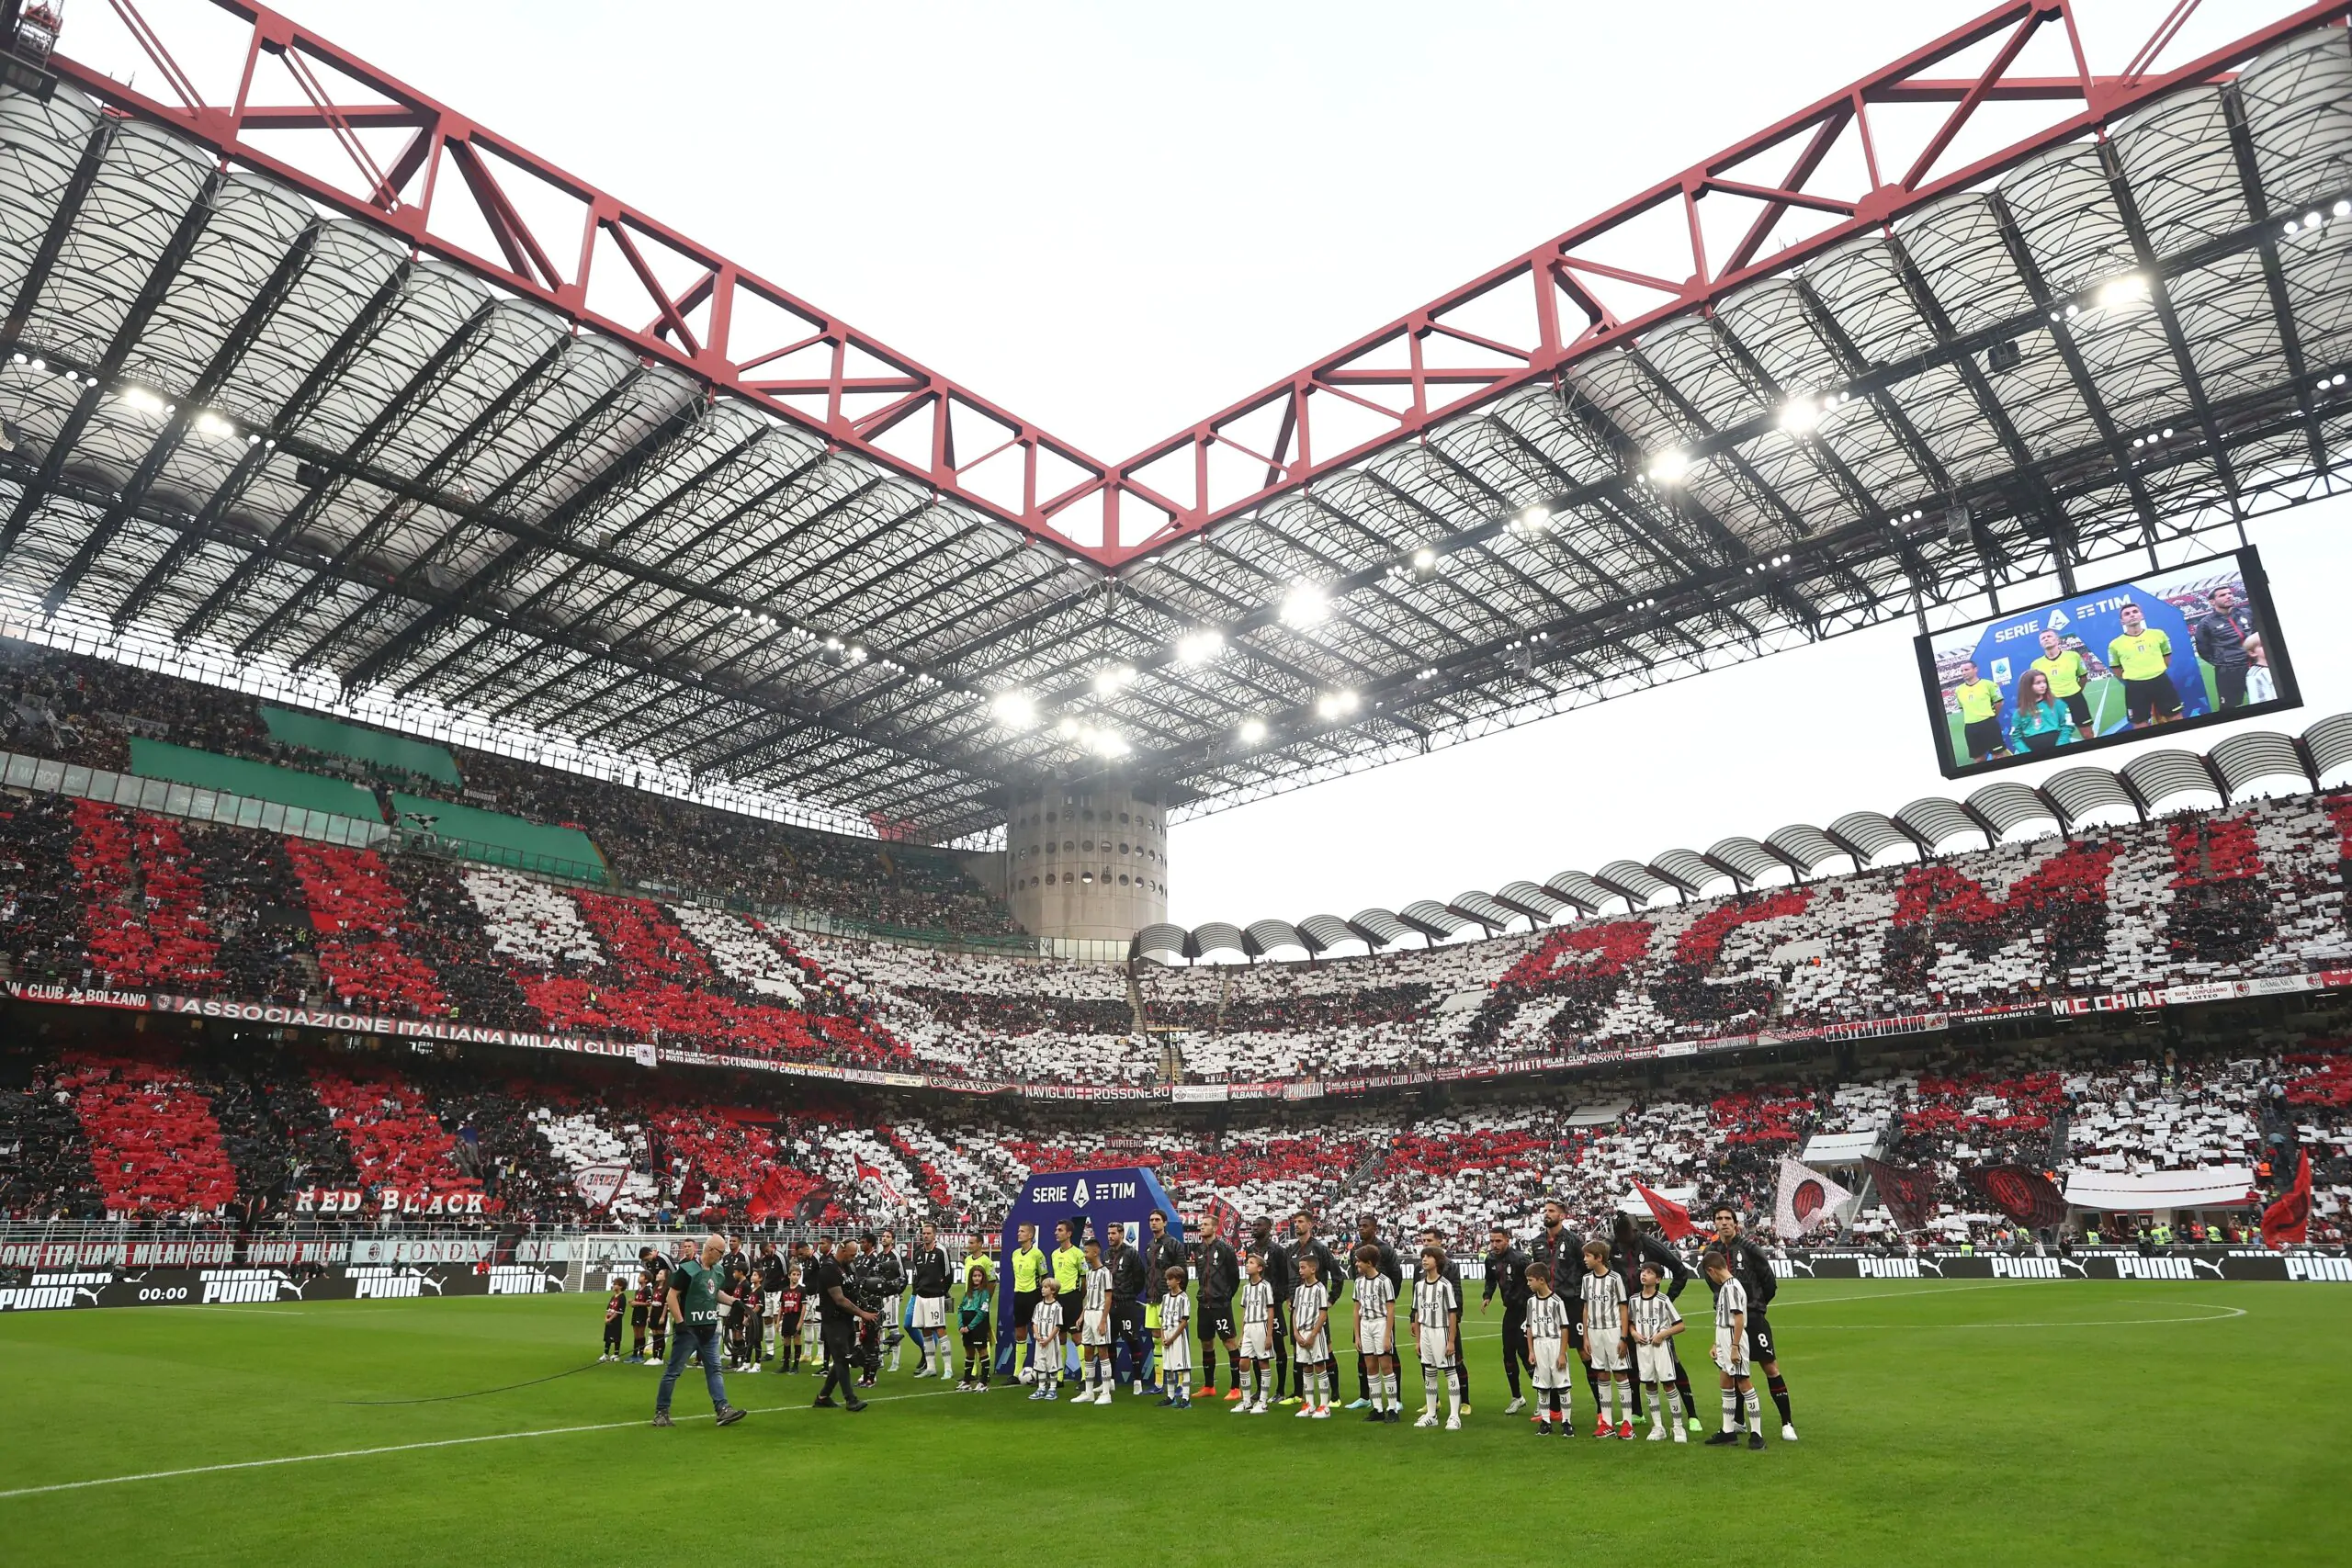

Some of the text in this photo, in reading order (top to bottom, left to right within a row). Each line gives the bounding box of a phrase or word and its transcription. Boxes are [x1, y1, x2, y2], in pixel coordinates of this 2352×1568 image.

[1995, 619, 2040, 644] SERIE
[2096, 594, 2132, 614] TIM
[28, 983, 64, 1000] CLUB
[85, 988, 147, 1008] BOLZANO
[2192, 987, 2228, 995] COMPLEANNO
[1949, 1008, 1983, 1018] MILAN
[1964, 1012, 2021, 1023] DESENZANO
[180, 999, 390, 1033] ASSOCIAZIONE
[398, 1019, 506, 1045] ITALIANA
[511, 1032, 578, 1052] MILAN
[584, 1041, 638, 1057] CLUB
[1826, 1015, 1926, 1042] CASTELFIDARDO
[666, 1048, 683, 1056] MILAN
[1588, 1054, 1623, 1064] KOSOVO
[666, 1054, 684, 1063] BUSTO
[684, 1056, 706, 1065] ARSIZIO
[729, 1056, 769, 1070] CUGGIONO
[1509, 1058, 1541, 1073] PINETO
[1543, 1054, 1588, 1066] MILAN CLUB
[779, 1066, 843, 1079] CRANS MONTANA
[1369, 1076, 1388, 1088] MILAN
[1390, 1072, 1408, 1086] CLUB
[1409, 1070, 1432, 1084] LATINA
[931, 1077, 972, 1089] GRUPPO
[1289, 1082, 1324, 1098] PORLEZZA
[1331, 1080, 1350, 1089] MILAN
[1350, 1078, 1365, 1087] CLUB
[1025, 1086, 1170, 1100] NAVIGLIO ROSSONERO
[1231, 1090, 1263, 1100] ALBANIA
[1111, 1139, 1144, 1148] VIPITENO
[1032, 1186, 1068, 1203] SERIE
[1111, 1181, 1136, 1200] TIM
[296, 1190, 485, 1214] RED BLACK
[132, 1243, 189, 1265] MILAN
[192, 1243, 236, 1264] CLUB
[300, 1242, 349, 1262] MILAN
[568, 1242, 638, 1260] MILAN
[1857, 1258, 1921, 1278] PUMA
[1990, 1258, 2062, 1278] PUMA
[2115, 1258, 2195, 1280] PUMA
[356, 1277, 422, 1299] PUMA
[488, 1274, 546, 1294] PUMA
[139, 1287, 188, 1301] 00:00
[202, 1280, 278, 1303] PUMA
[1589, 1291, 1608, 1304] Jeep
[0, 1287, 76, 1311] PUMA
[1421, 1301, 1440, 1312] Jeep
[691, 1311, 705, 1322] TV
[931, 1311, 940, 1320] 19
[1533, 1316, 1552, 1325] Jeep
[1638, 1317, 1657, 1326] Jeep
[1122, 1320, 1132, 1331] 19
[1216, 1319, 1229, 1331] 32
[1576, 1323, 1583, 1336] 9
[1758, 1334, 1769, 1348] 8
